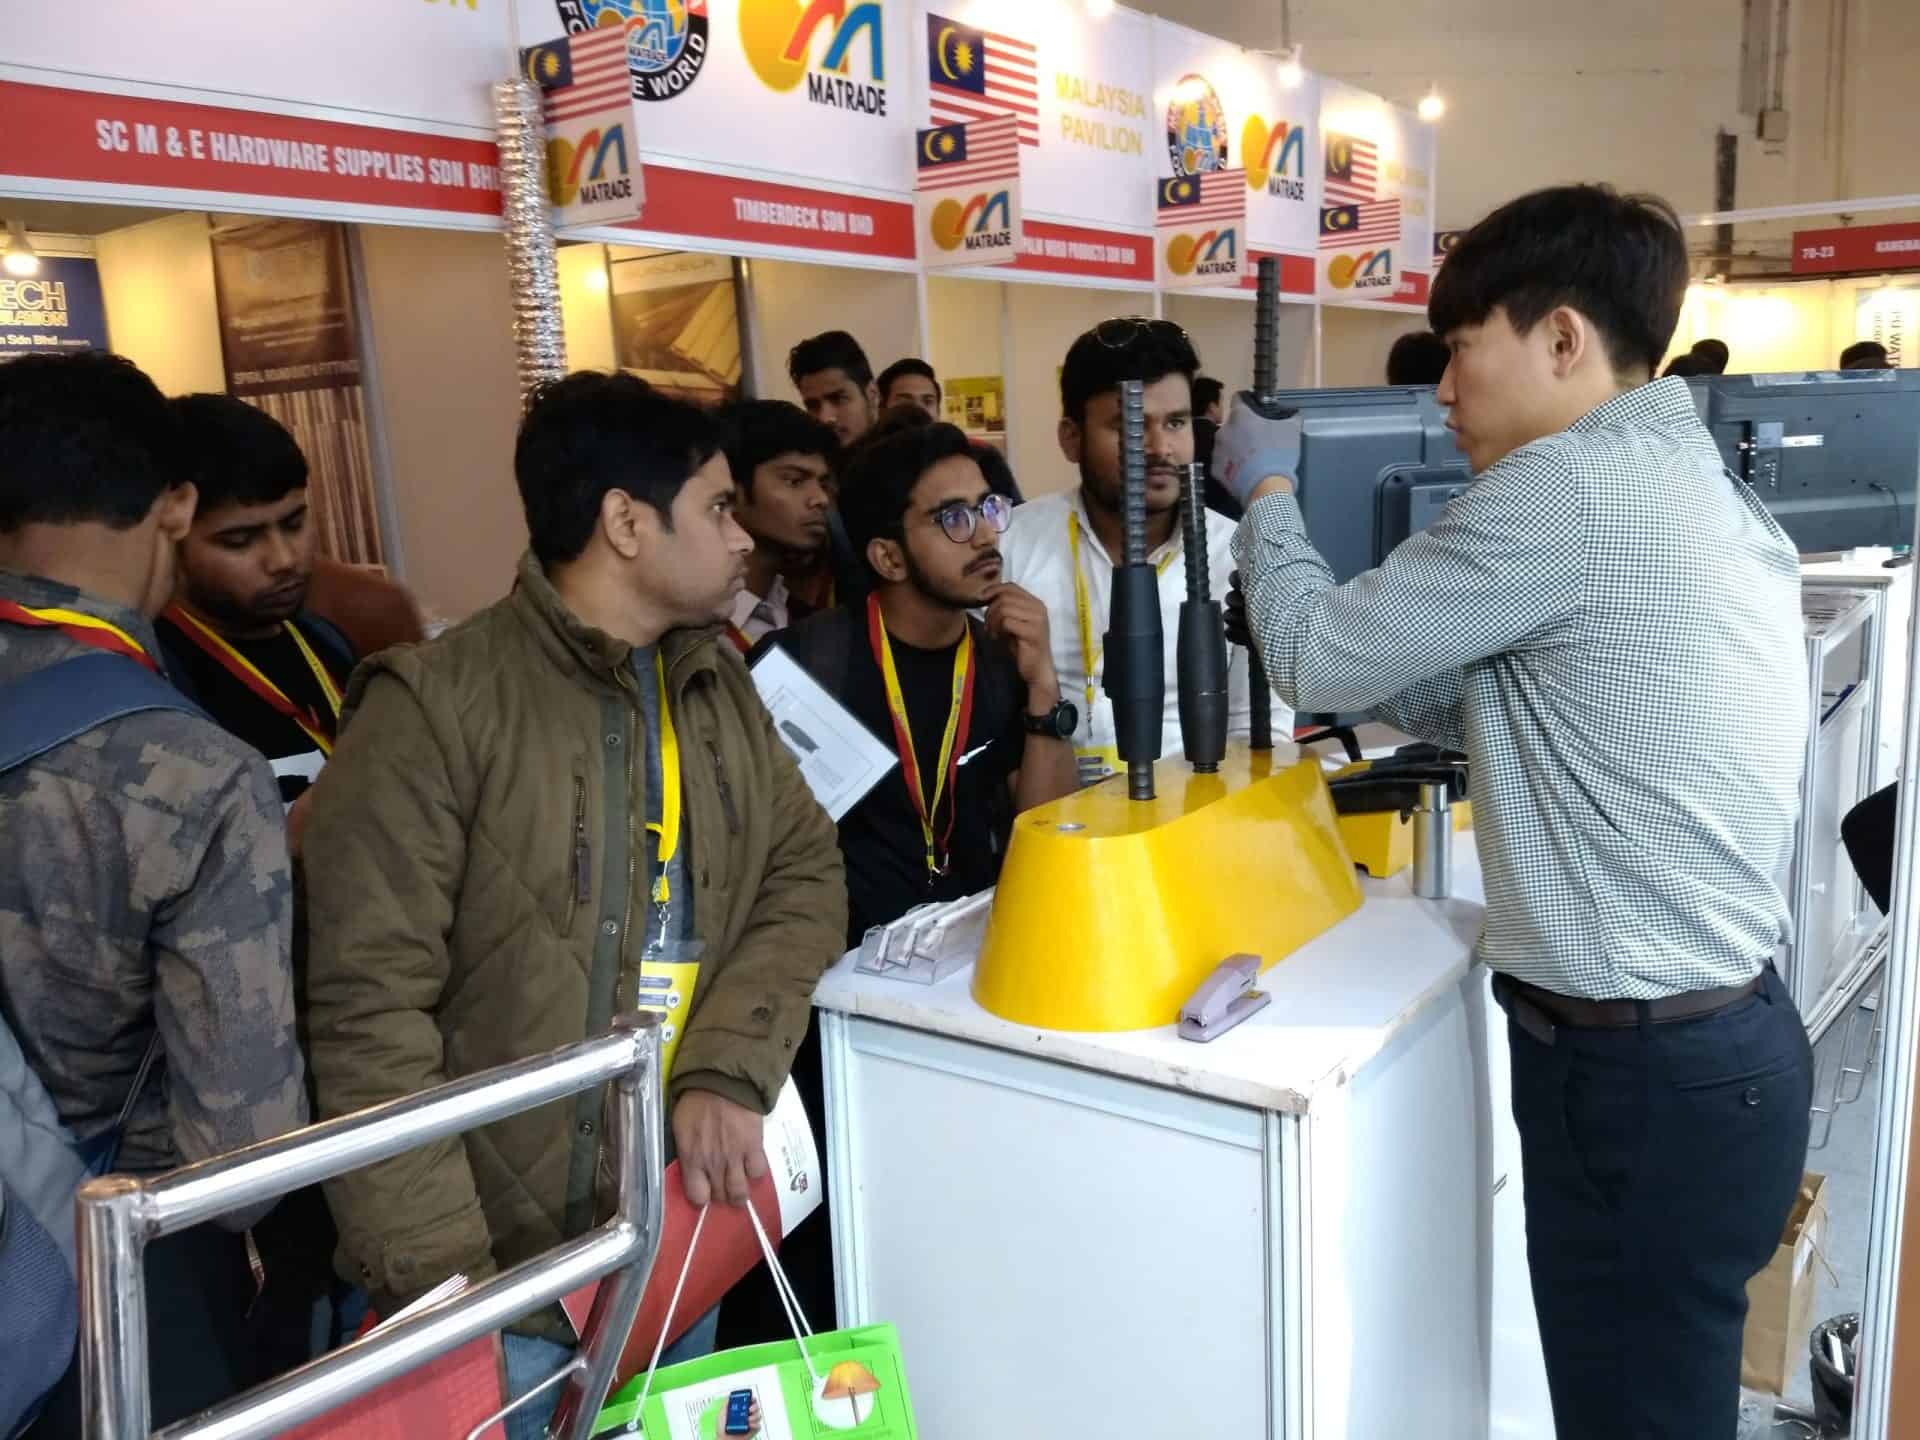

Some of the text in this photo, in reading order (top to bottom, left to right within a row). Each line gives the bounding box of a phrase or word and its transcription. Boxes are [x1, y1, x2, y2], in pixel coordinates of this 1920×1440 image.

[649, 33, 706, 96] WORLD
[808, 73, 887, 117] MATRADE
[1056, 72, 1145, 118] MALAYSIA
[1061, 114, 1142, 157] PAVILION
[96, 119, 129, 152] SC
[134, 123, 159, 155] M
[166, 127, 184, 158] &
[189, 129, 205, 160] E
[209, 131, 330, 174] HARDWARE
[333, 146, 424, 184] SUPPLIES
[429, 157, 465, 188] SDN
[580, 178, 632, 205] MATRADE
[1269, 175, 1305, 202] MATRADE
[733, 197, 819, 230] TIMBERDECK
[821, 208, 846, 232] SDN
[965, 231, 1012, 251] MATRADE
[1196, 260, 1237, 276] MATRADE
[1354, 275, 1392, 289] MATRADE
